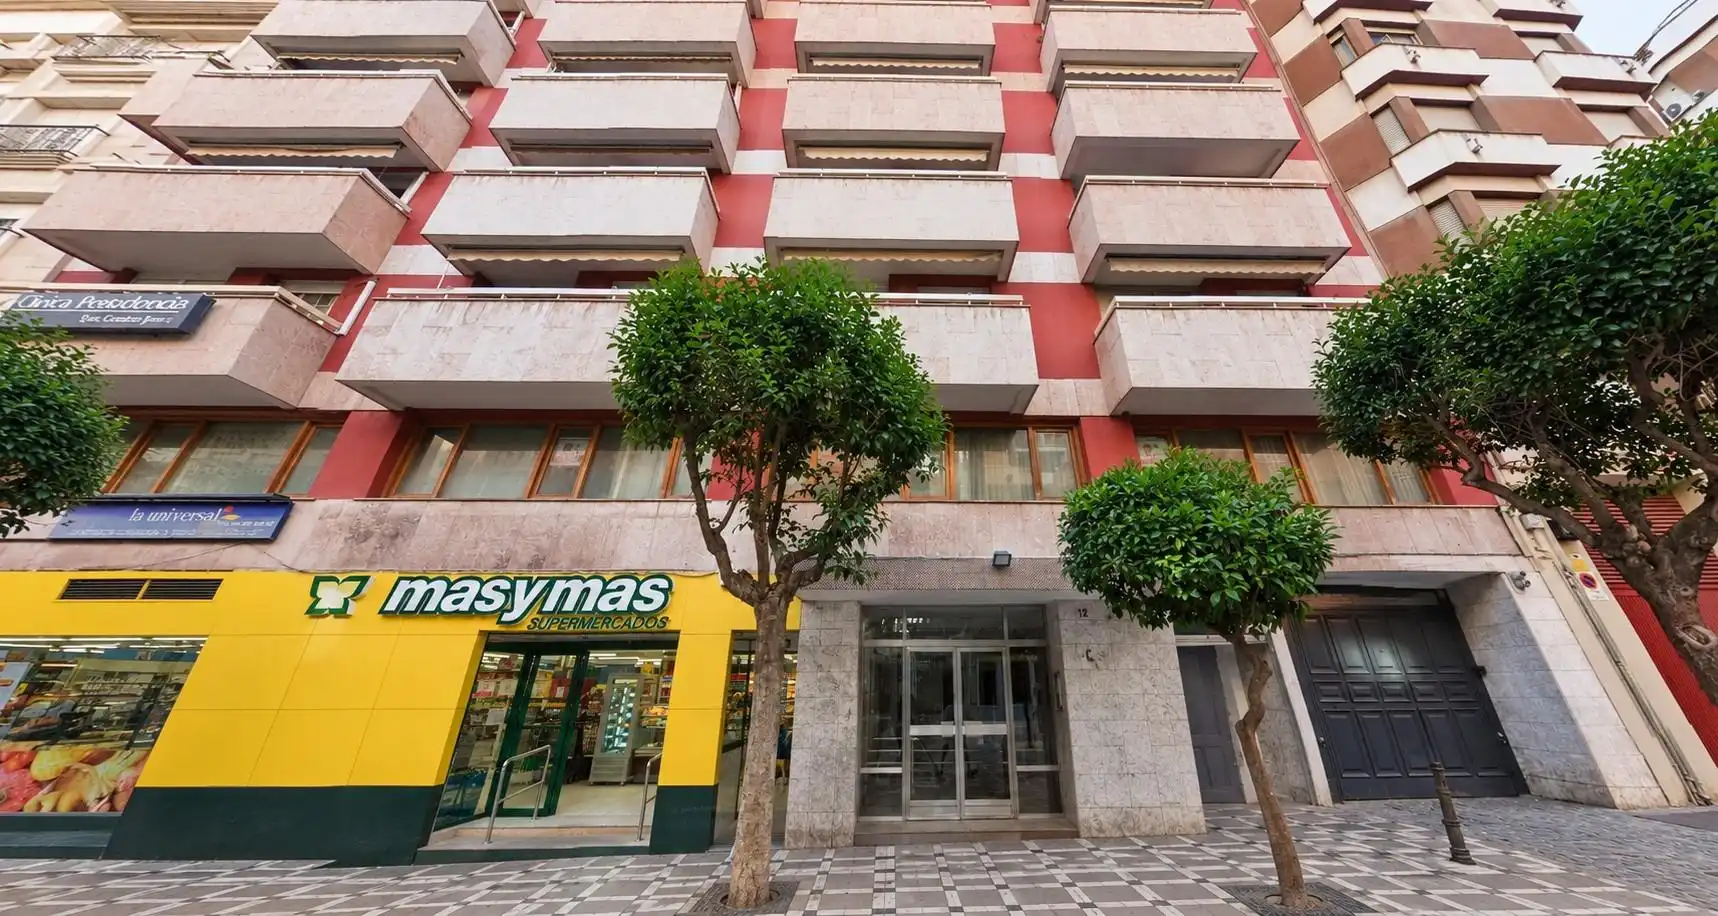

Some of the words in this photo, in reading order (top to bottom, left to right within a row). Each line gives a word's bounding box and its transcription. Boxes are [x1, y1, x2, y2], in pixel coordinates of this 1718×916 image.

[129, 508, 145, 521] la
[147, 507, 222, 522] universal
[380, 575, 673, 625] masymas
[1078, 608, 1088, 618] 12
[527, 616, 669, 630] SUPERMERCADOS
